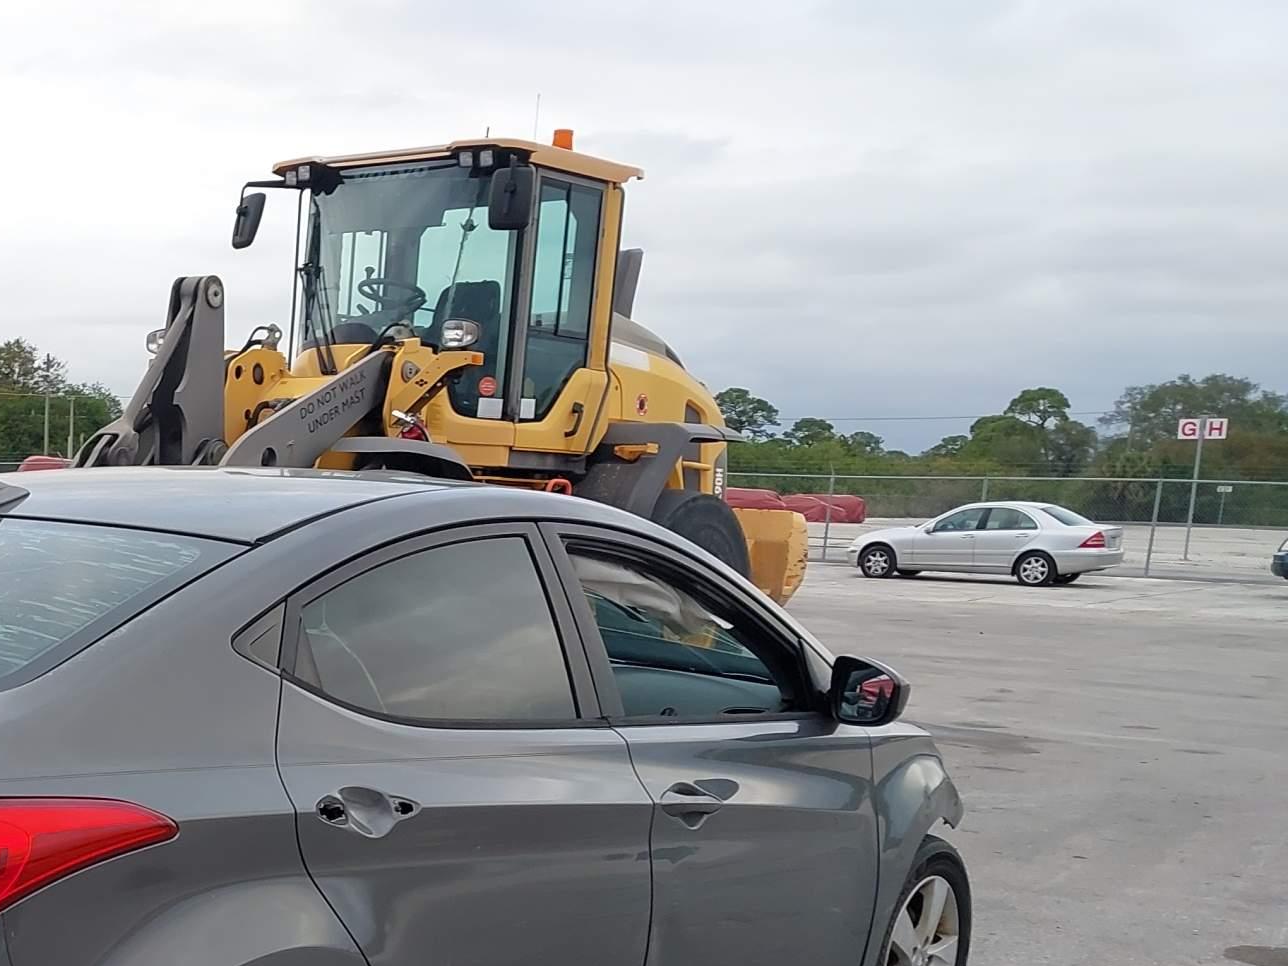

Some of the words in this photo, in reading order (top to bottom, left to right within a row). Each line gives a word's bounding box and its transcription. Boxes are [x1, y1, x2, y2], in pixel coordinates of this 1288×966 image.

[299, 403, 314, 420] DO
[316, 388, 338, 408] NOT
[340, 370, 367, 393] WALK
[307, 406, 340, 433] UNDER
[342, 387, 367, 410] MAST
[1181, 421, 1197, 437] G
[1208, 421, 1224, 437] H
